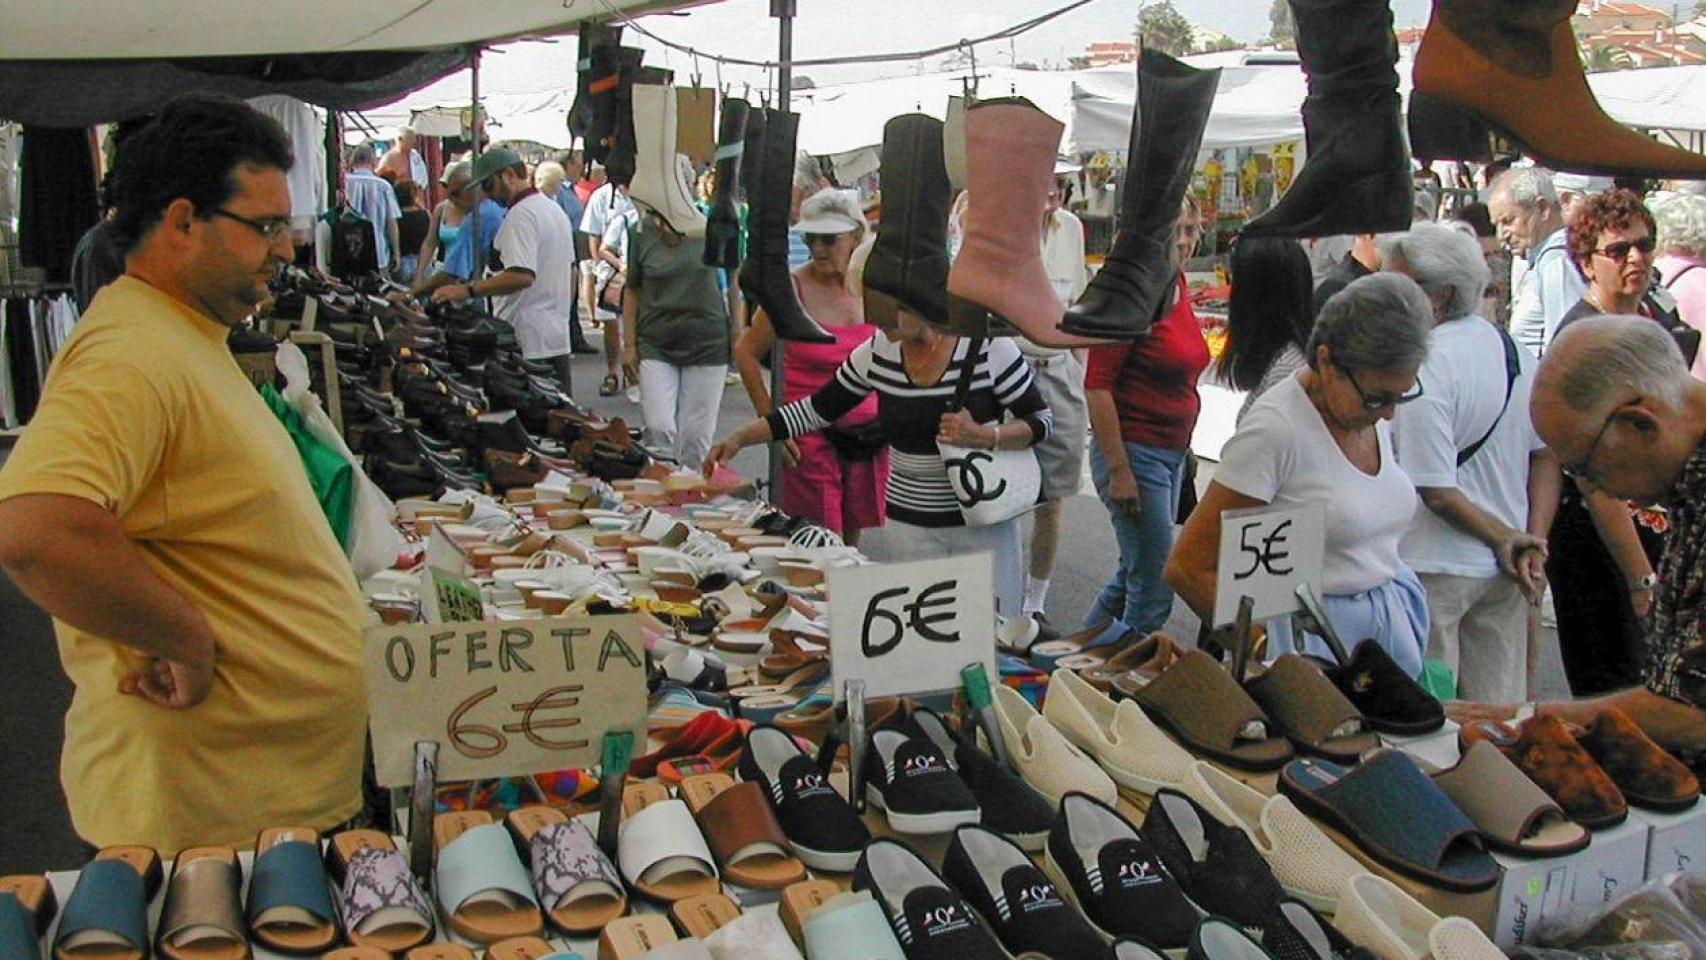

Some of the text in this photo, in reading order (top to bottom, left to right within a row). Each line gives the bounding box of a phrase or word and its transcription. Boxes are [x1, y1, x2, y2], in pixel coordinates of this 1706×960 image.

[1234, 520, 1293, 579] 5€
[862, 580, 960, 657] 6€
[385, 627, 641, 682] OFERTA
[447, 685, 588, 758] 6€
